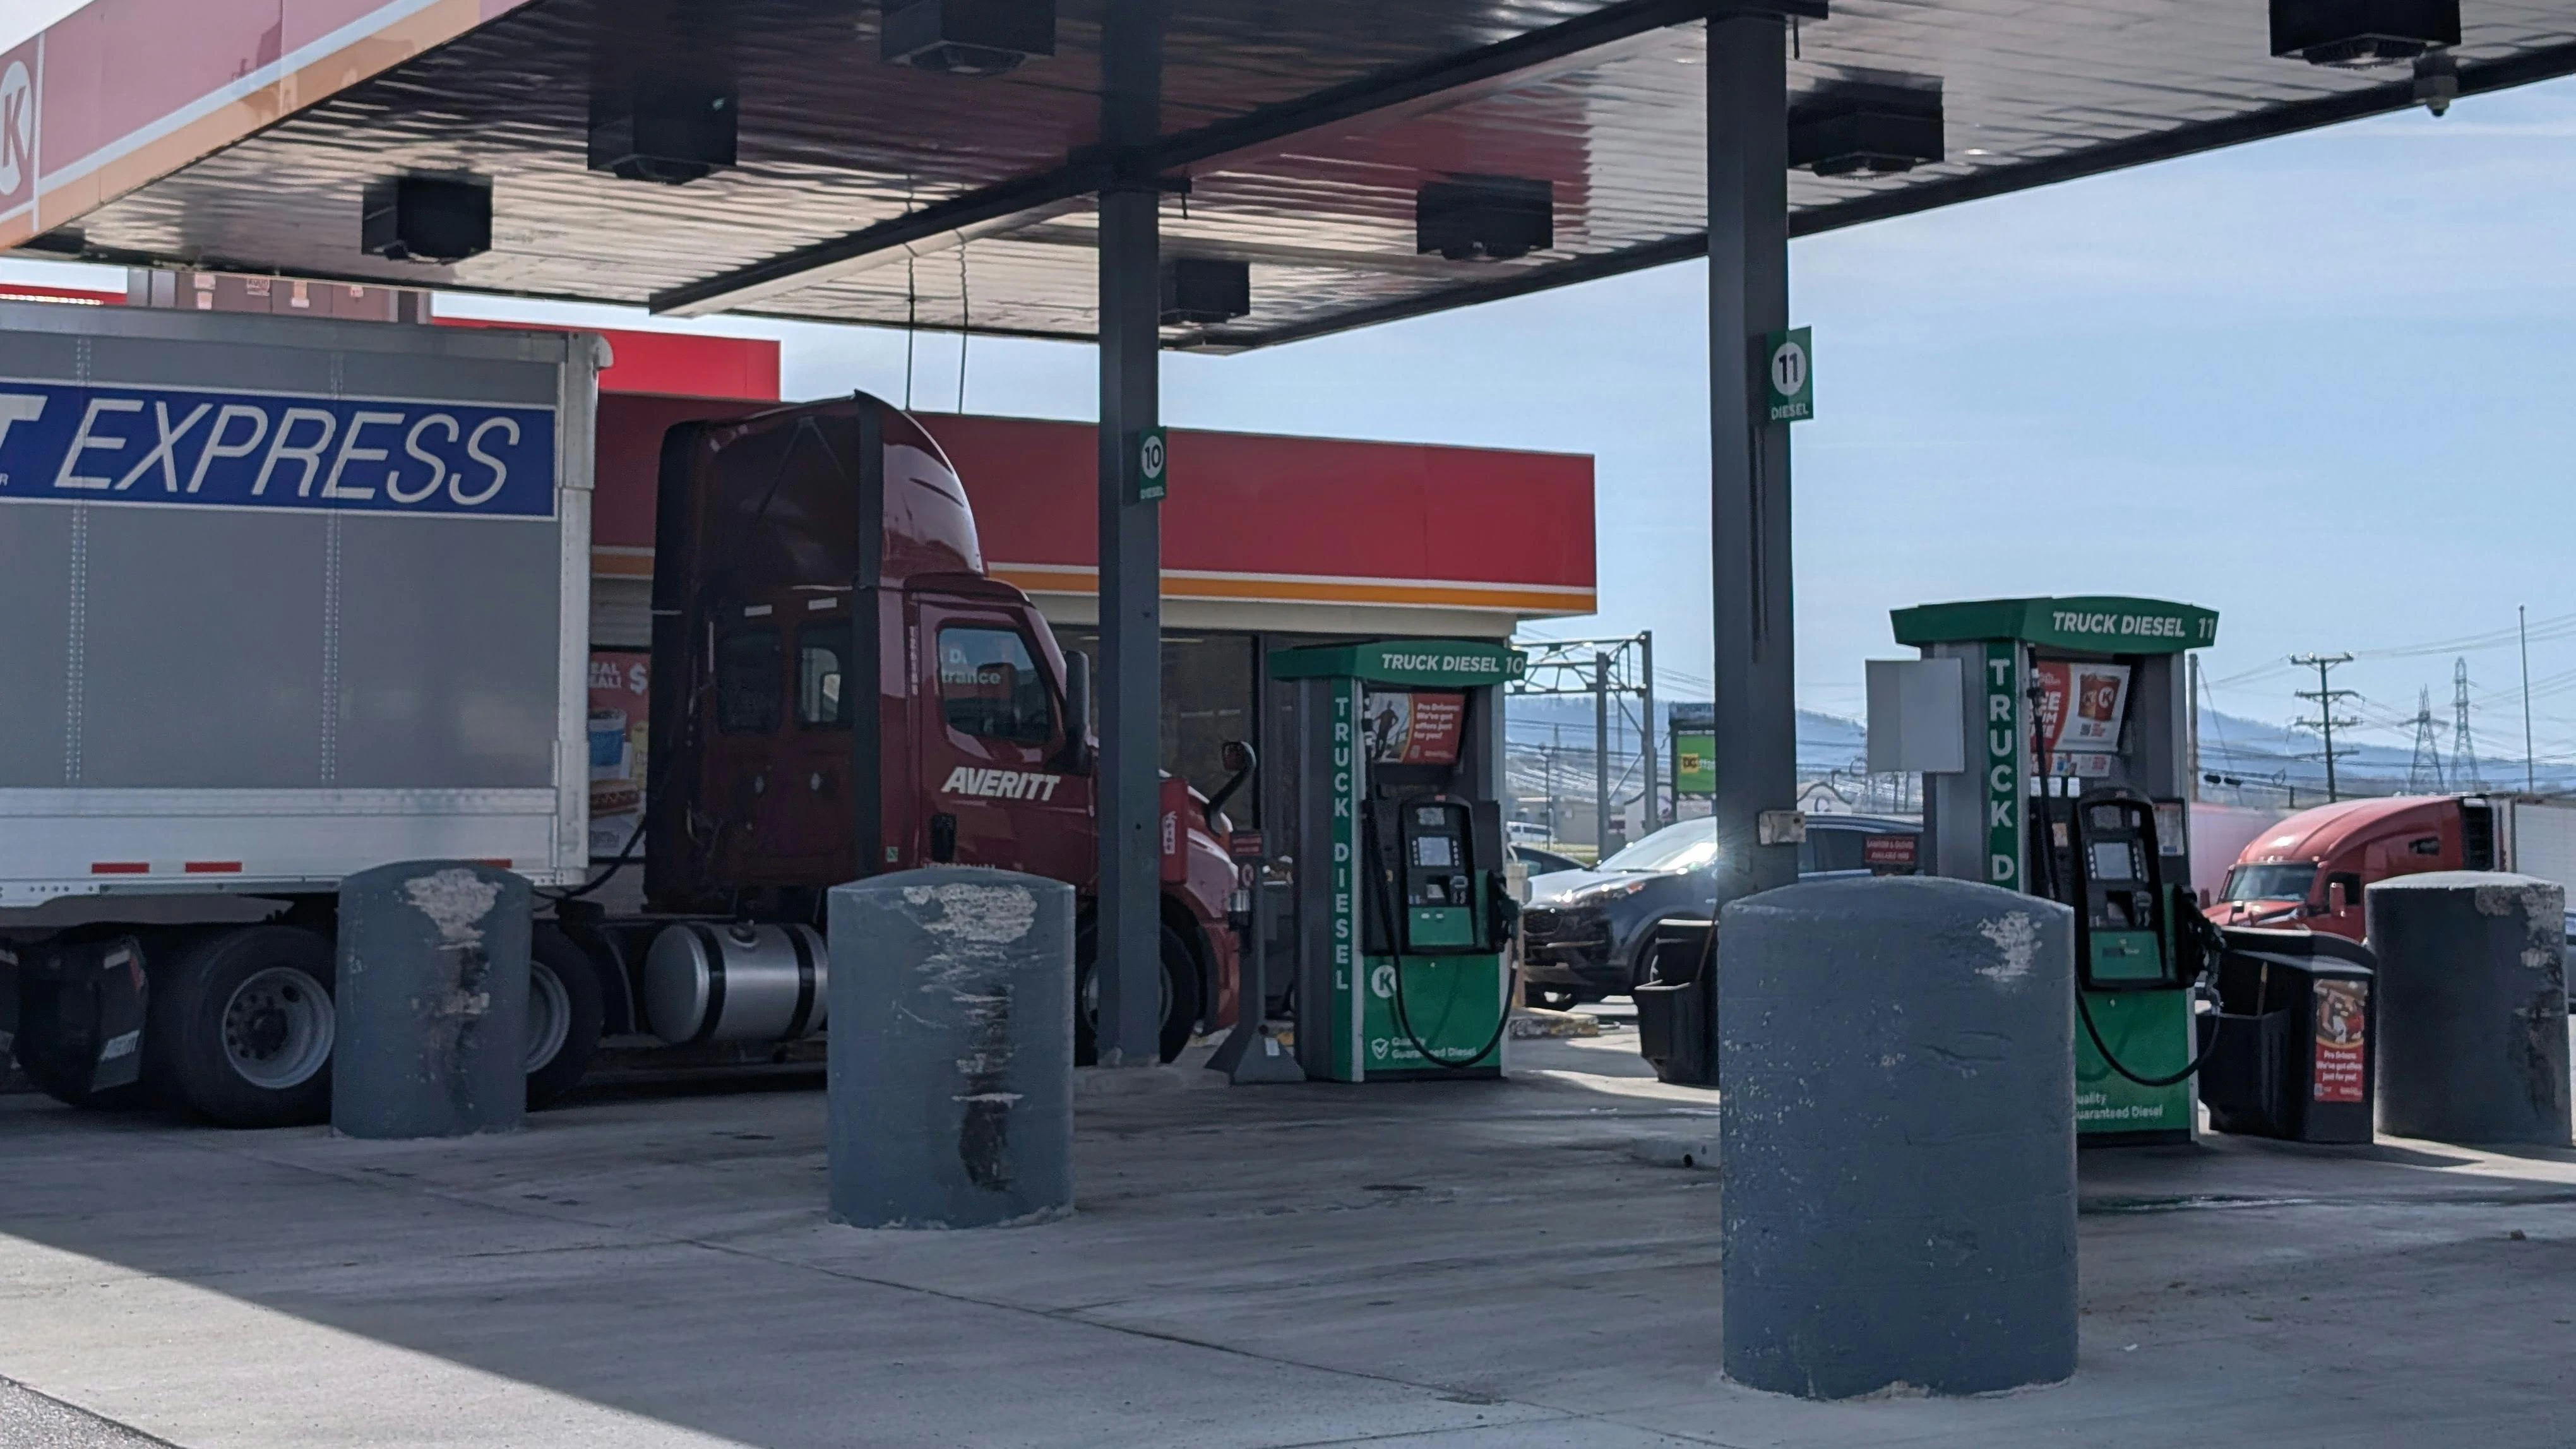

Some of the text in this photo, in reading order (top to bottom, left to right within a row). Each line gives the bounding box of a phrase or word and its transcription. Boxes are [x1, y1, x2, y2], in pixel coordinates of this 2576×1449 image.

[1778, 352, 1799, 385] 11
[1770, 402, 1809, 420] DIESEL
[54, 397, 520, 506] EXPRESS
[1144, 444, 1162, 470] 10
[2053, 611, 2215, 639] TRUCK DIESEL 11
[629, 662, 649, 695] $
[1381, 653, 1525, 674] TRUCK DIESEL 10
[1334, 696, 1349, 818] TRUCK
[1989, 658, 2013, 828] TRUCK
[940, 766, 1061, 801] AVERITT
[1333, 842, 1349, 990] DIESEL
[2075, 1092, 2108, 1106] uality
[2075, 1106, 2130, 1120] uaranteed
